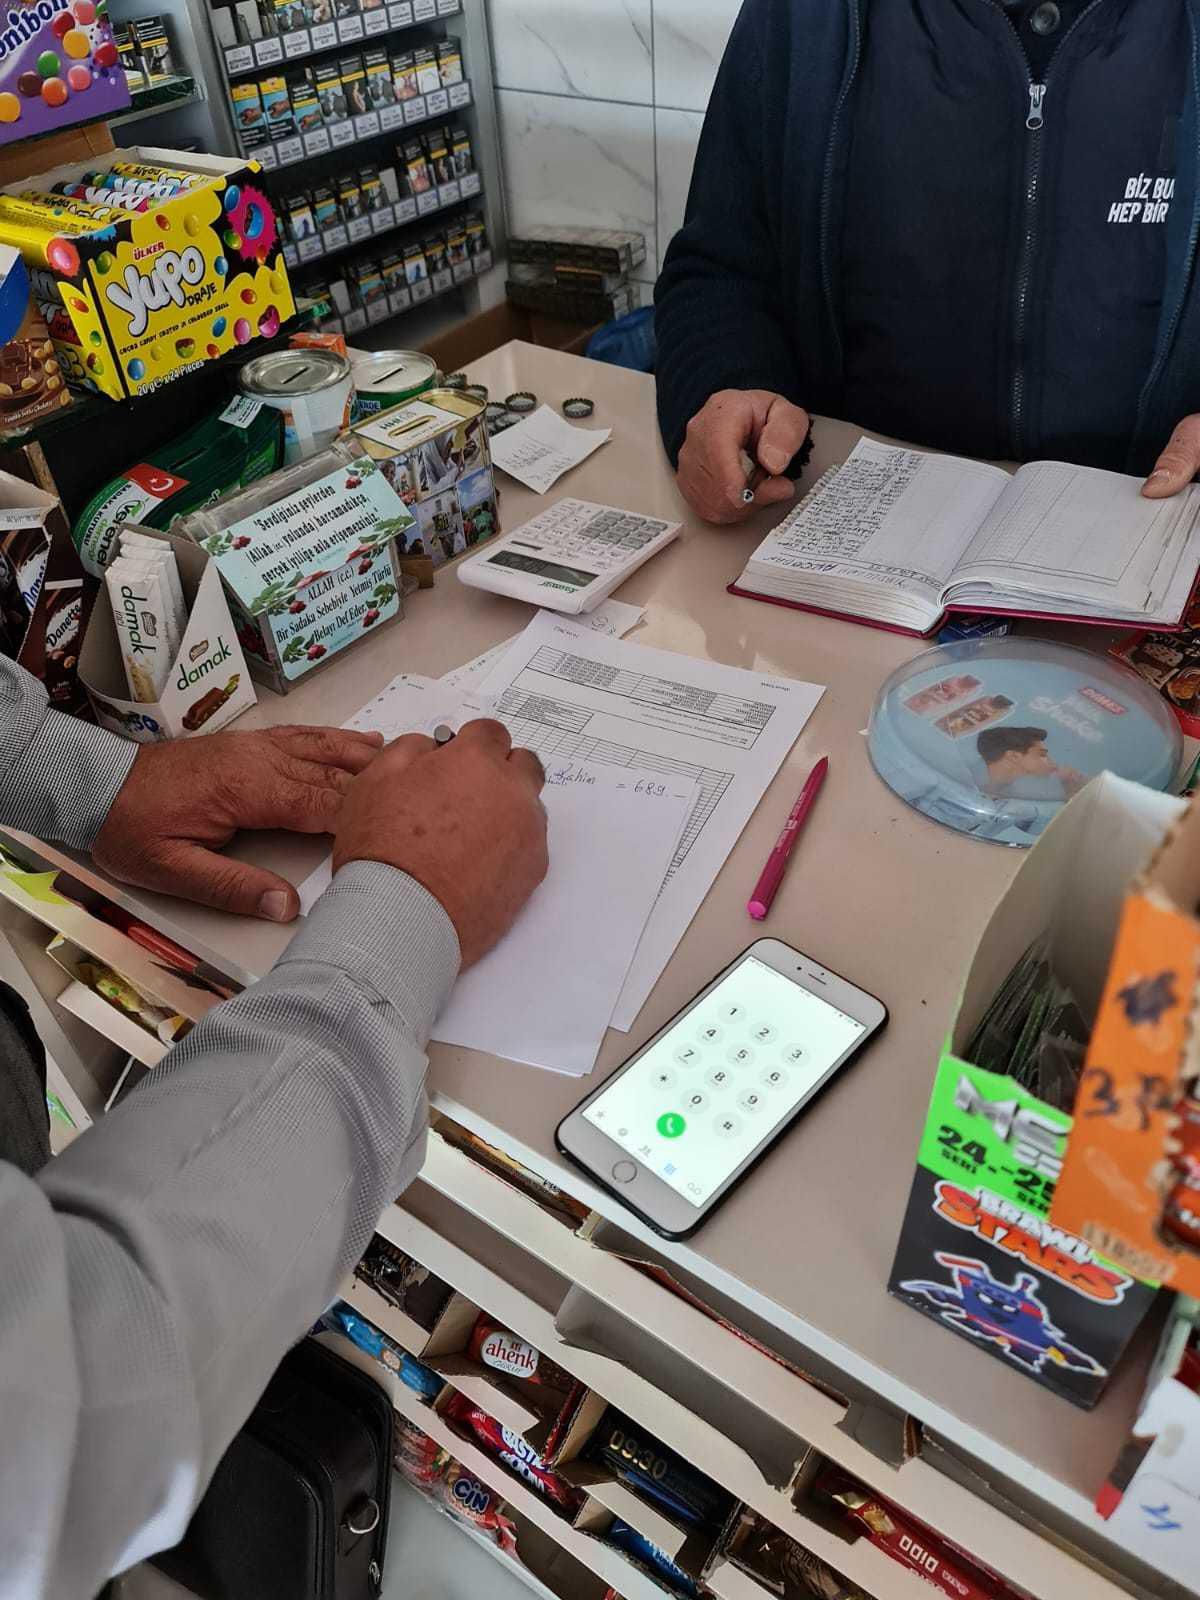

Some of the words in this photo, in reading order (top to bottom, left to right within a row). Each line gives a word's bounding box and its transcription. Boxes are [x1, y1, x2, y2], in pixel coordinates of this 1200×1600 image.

[1124, 172, 1153, 199] BİZ
[1107, 202, 1142, 223] HEP
[133, 241, 165, 261] ÜLKER
[187, 282, 218, 307] DRAJE
[261, 560, 289, 586] gerçek
[307, 575, 336, 601] ALLAH
[276, 626, 290, 644] Bir
[288, 612, 317, 636] Sadaka
[315, 591, 350, 618] Sebebiyle
[371, 565, 392, 583] Türlü
[120, 585, 157, 655] damak
[176, 636, 233, 691] damak
[705, 1027, 718, 1039] 4
[758, 1026, 770, 1038] 2
[683, 1048, 695, 1060] 7
[736, 1048, 749, 1061] 5
[791, 1048, 803, 1061] 3
[713, 1070, 726, 1084] 8
[769, 1070, 781, 1083] 6
[690, 1094, 703, 1106] 0
[937, 1125, 987, 1165] 24
[935, 1182, 1130, 1303] STARS
[486, 1338, 536, 1371] ahenk
